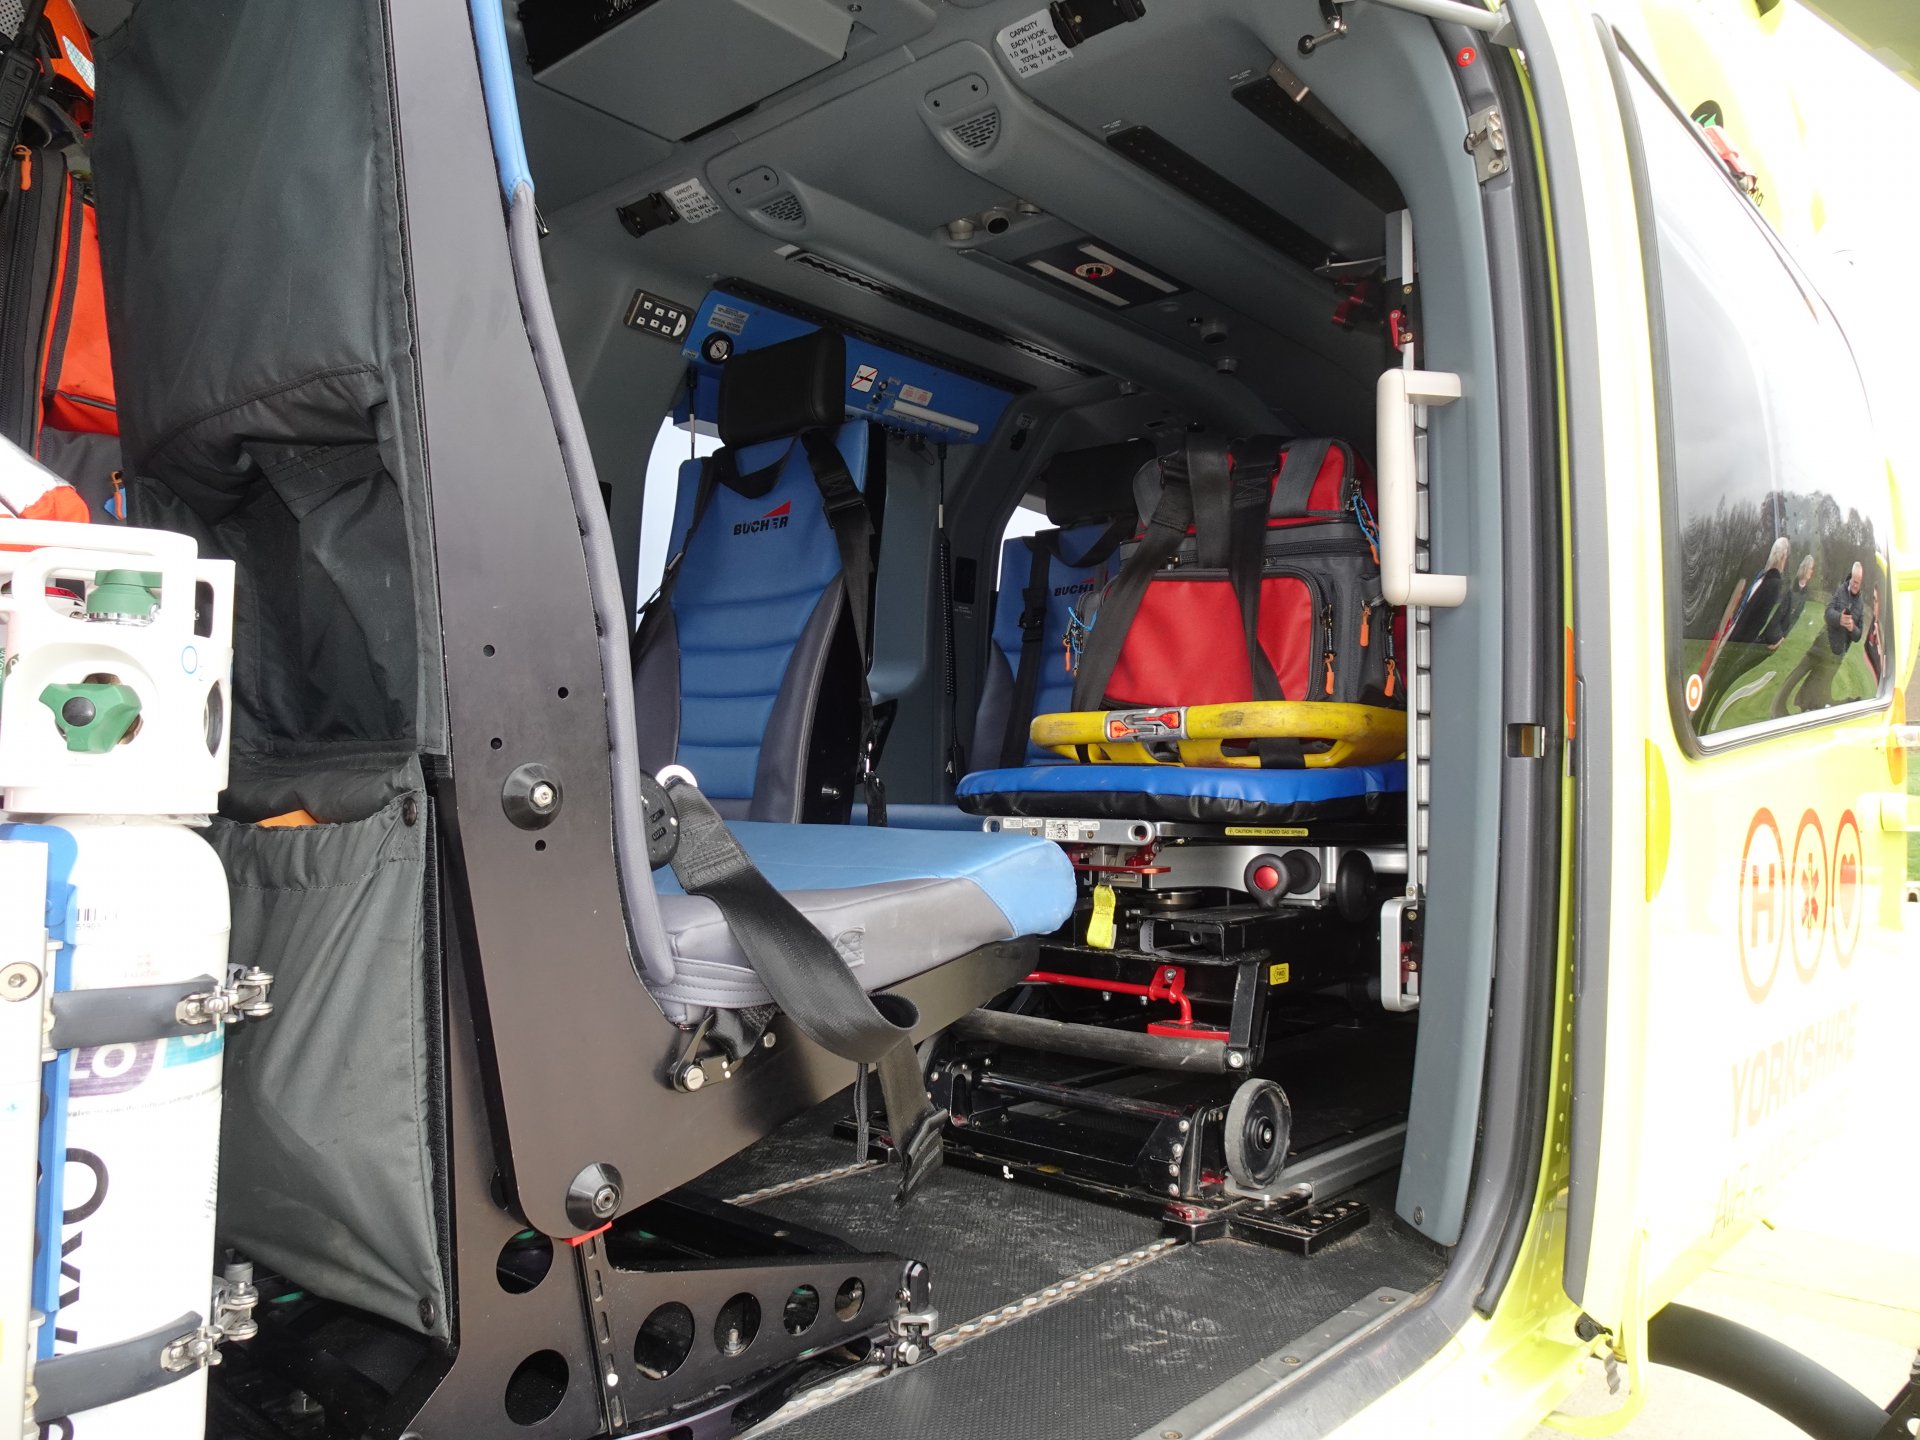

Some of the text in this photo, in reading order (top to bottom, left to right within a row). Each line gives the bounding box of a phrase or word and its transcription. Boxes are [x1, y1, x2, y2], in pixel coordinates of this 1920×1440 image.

[1009, 20, 1038, 38] CAPACITY
[1009, 51, 1019, 59] 1.0
[1020, 47, 1029, 56] kg
[1037, 38, 1047, 47] 2.2
[1010, 37, 1028, 50] EACH
[1020, 53, 1040, 64] TOTAL
[733, 516, 789, 536] BUCHER
[1054, 583, 1094, 597] BUCH
[1730, 1002, 1860, 1139] YORKSHIRE
